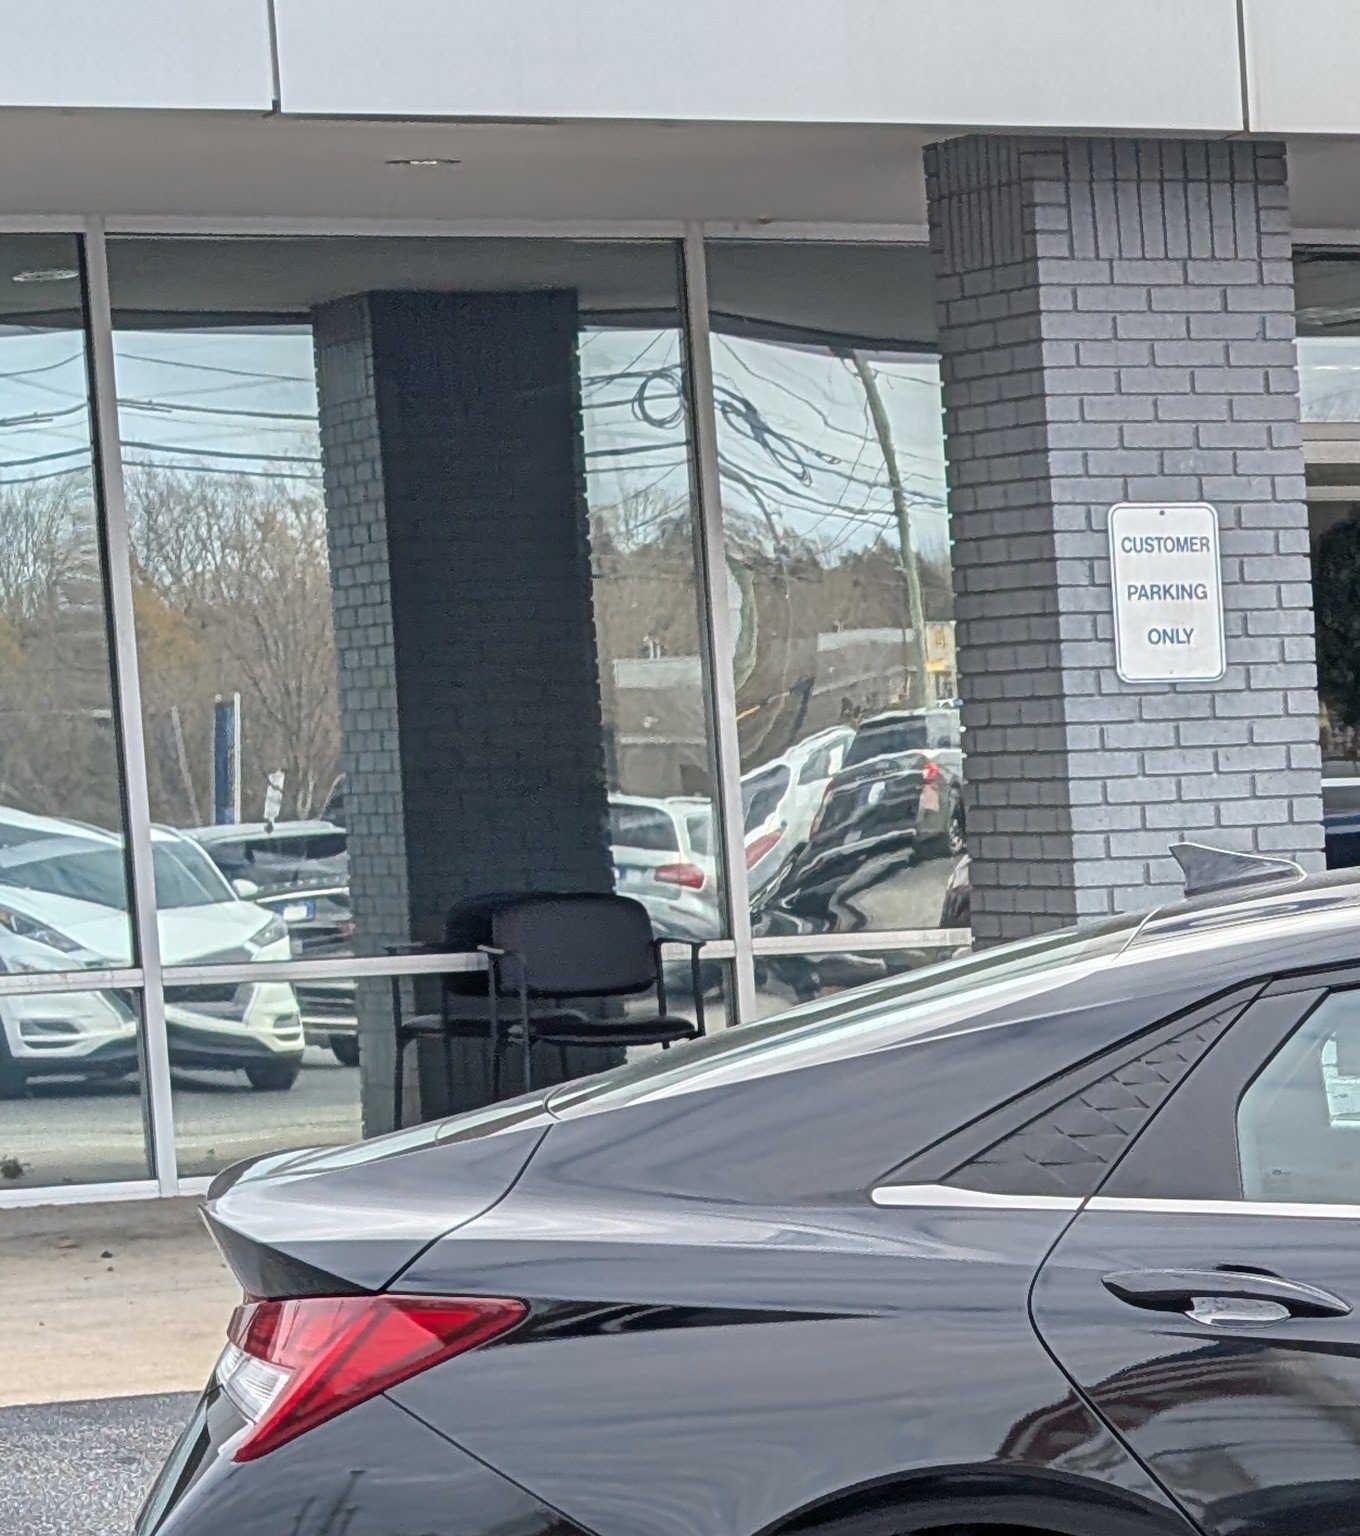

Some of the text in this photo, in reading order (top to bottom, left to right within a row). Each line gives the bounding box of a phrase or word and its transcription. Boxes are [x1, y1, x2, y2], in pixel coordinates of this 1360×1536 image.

[1121, 536, 1210, 554] CUSTOMER
[1127, 583, 1208, 601] PARKING
[1147, 627, 1195, 646] ONLY
